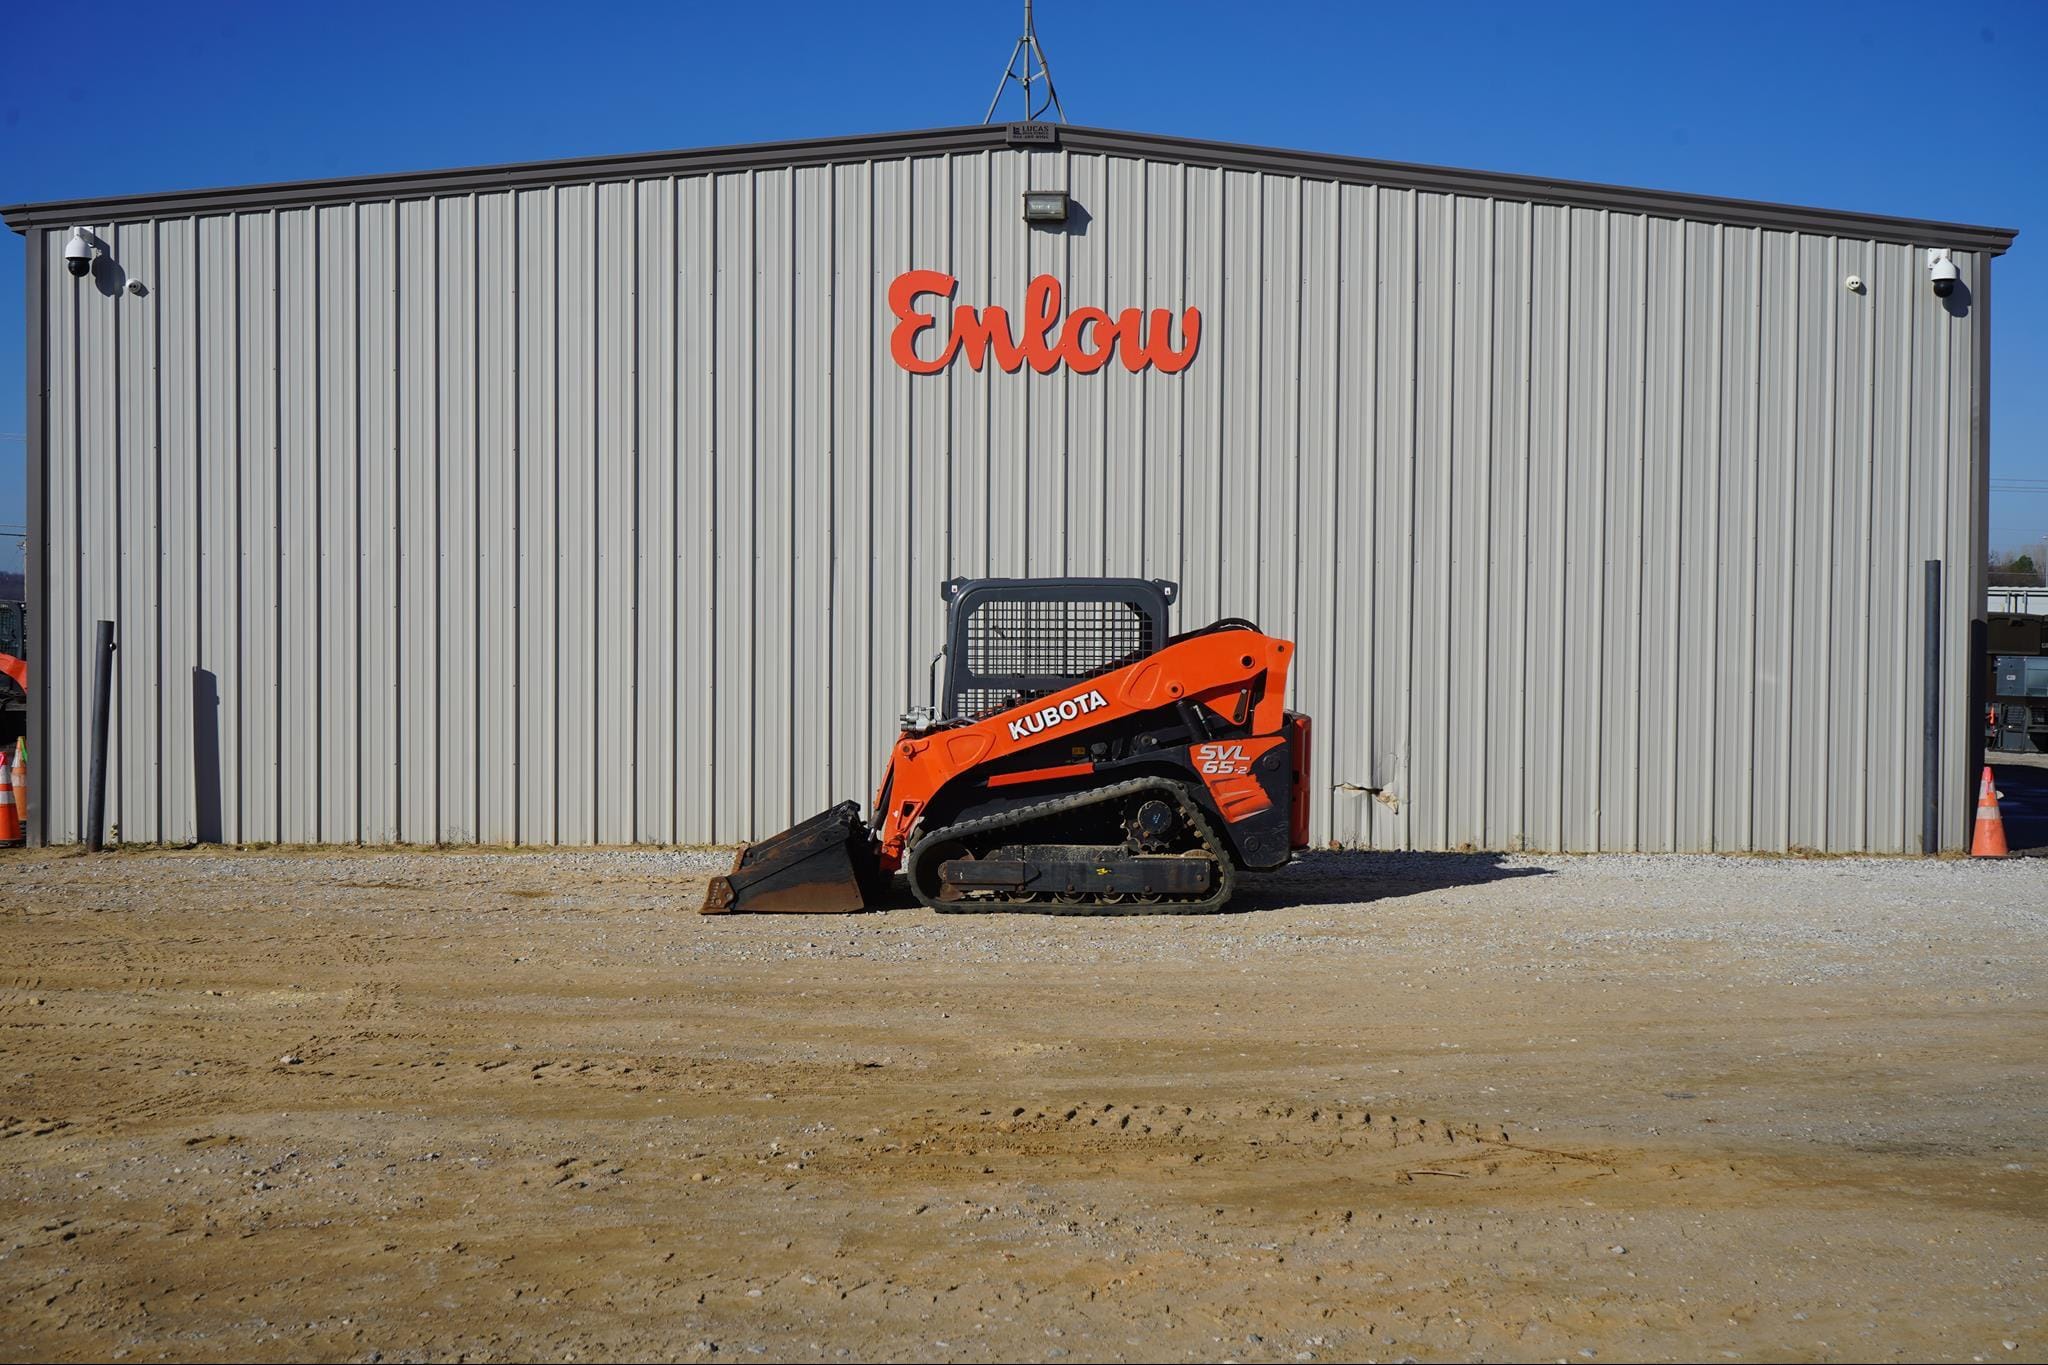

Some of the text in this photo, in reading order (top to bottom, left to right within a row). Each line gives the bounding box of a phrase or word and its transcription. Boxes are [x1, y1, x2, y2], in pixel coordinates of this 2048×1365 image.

[1007, 689, 1109, 741] KUBOTA
[1197, 745, 1251, 761] SVL
[1202, 760, 1248, 775] 65-2
